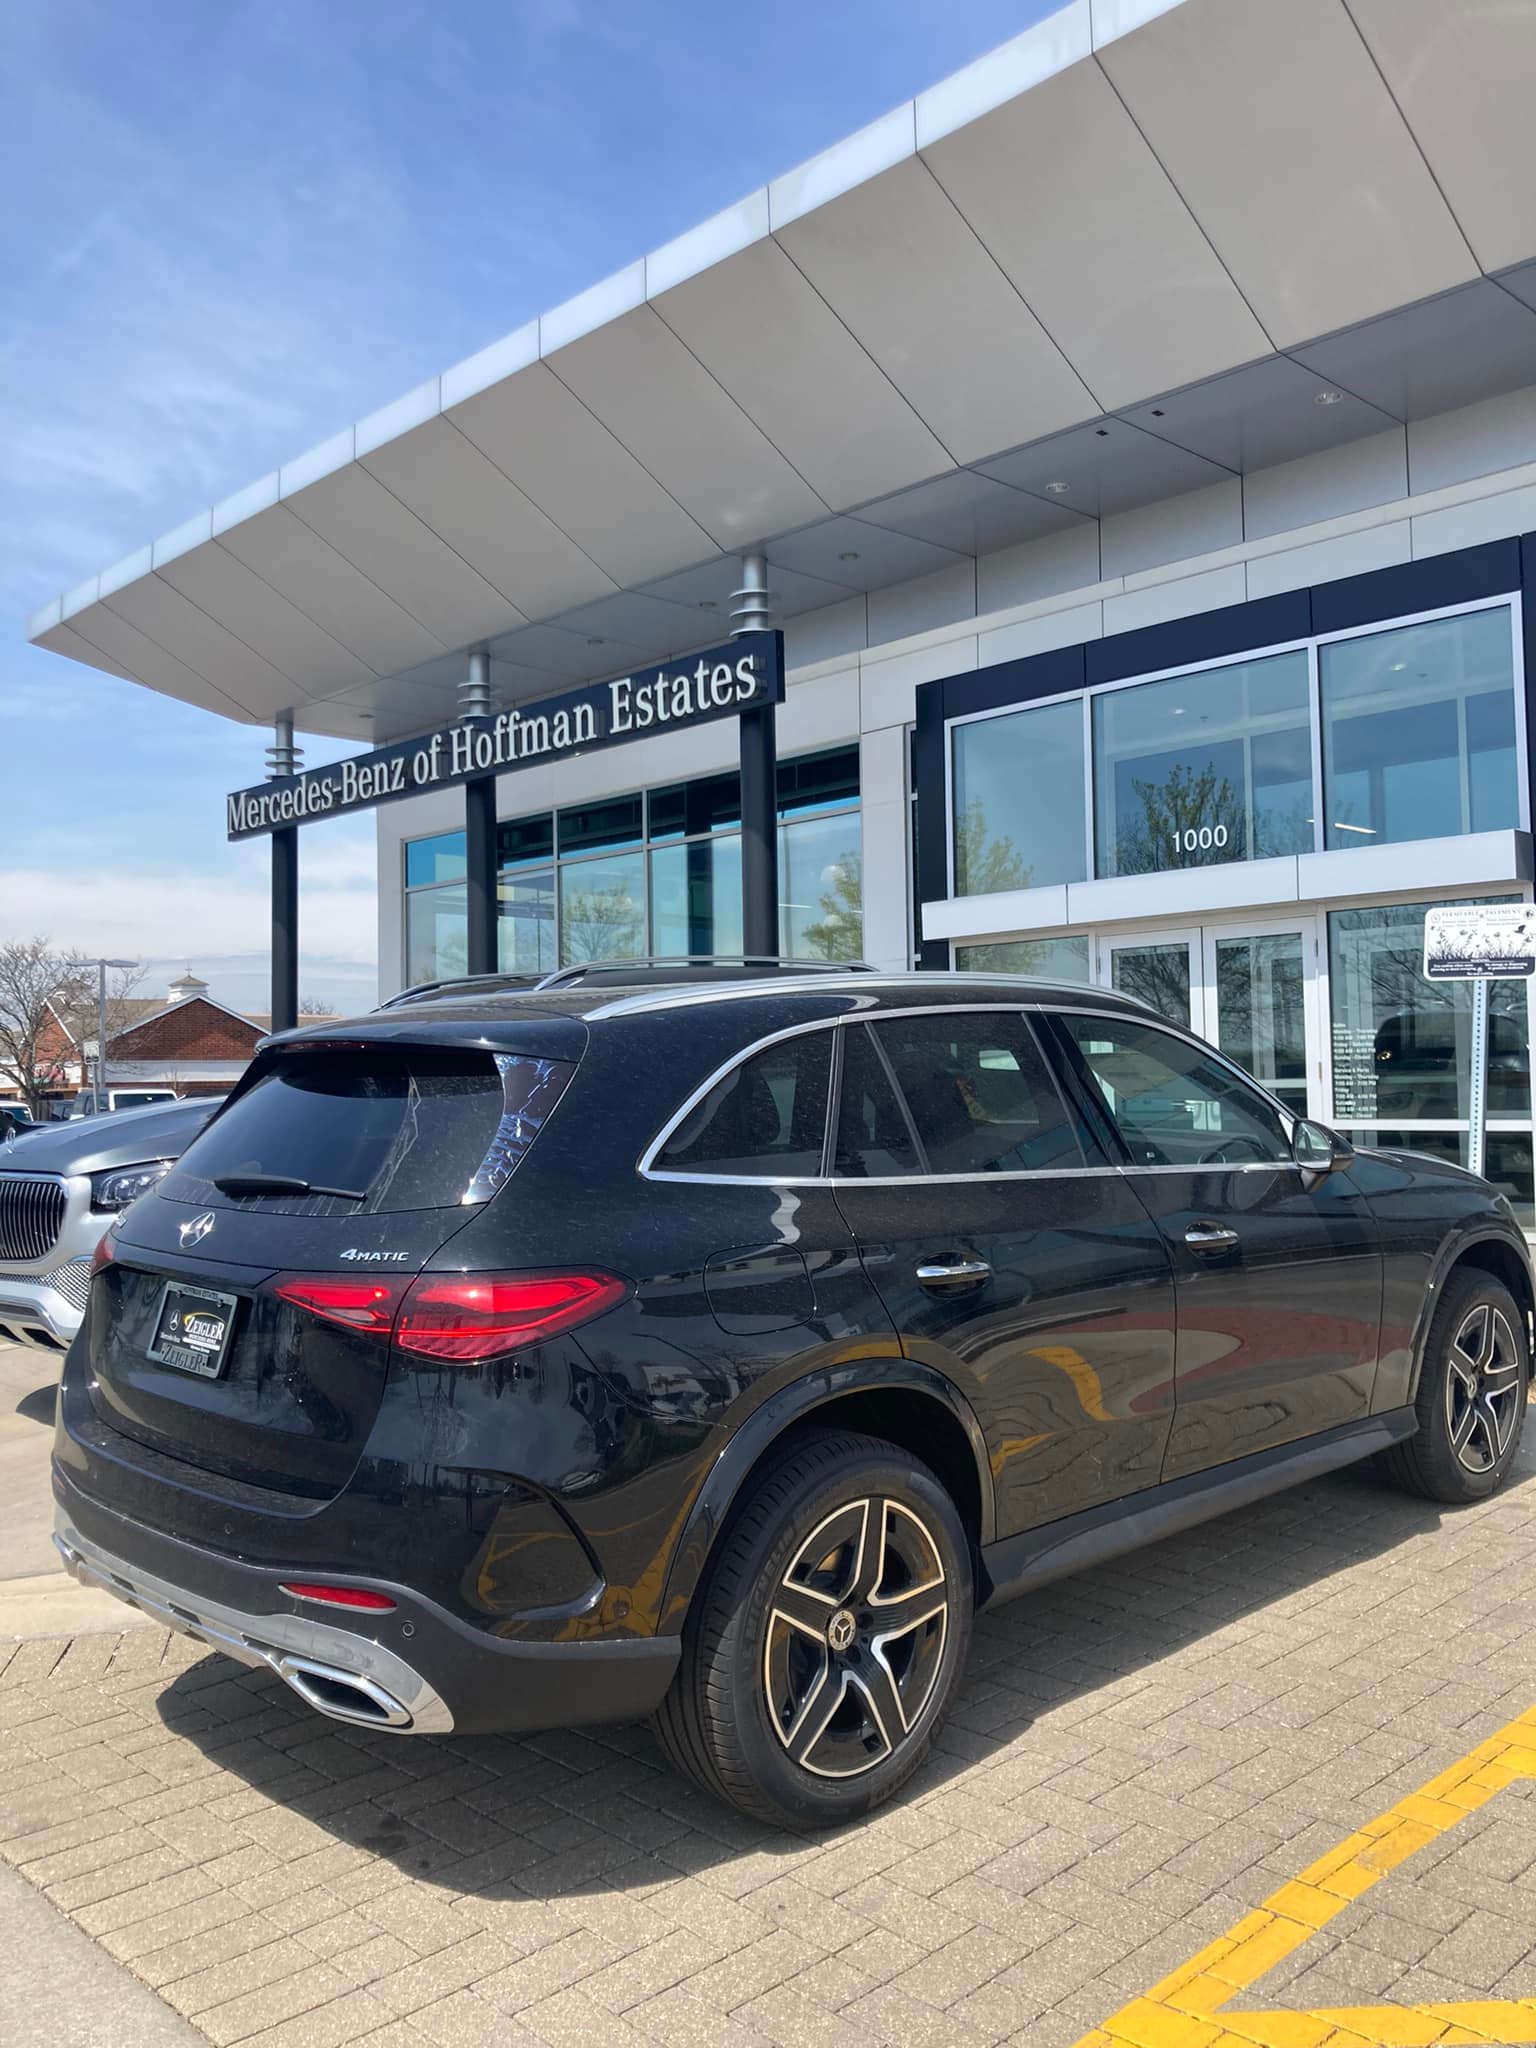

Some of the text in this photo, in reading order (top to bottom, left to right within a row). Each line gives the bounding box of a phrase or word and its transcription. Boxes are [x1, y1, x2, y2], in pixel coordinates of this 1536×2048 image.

[227, 653, 757, 835] Mercedes-Benz of Hoffman Estates
[1172, 824, 1228, 853] 1000
[340, 1248, 409, 1261] 4MATIC
[185, 1316, 225, 1340] ZEIGLER
[162, 1344, 203, 1372] ZEIGLER
